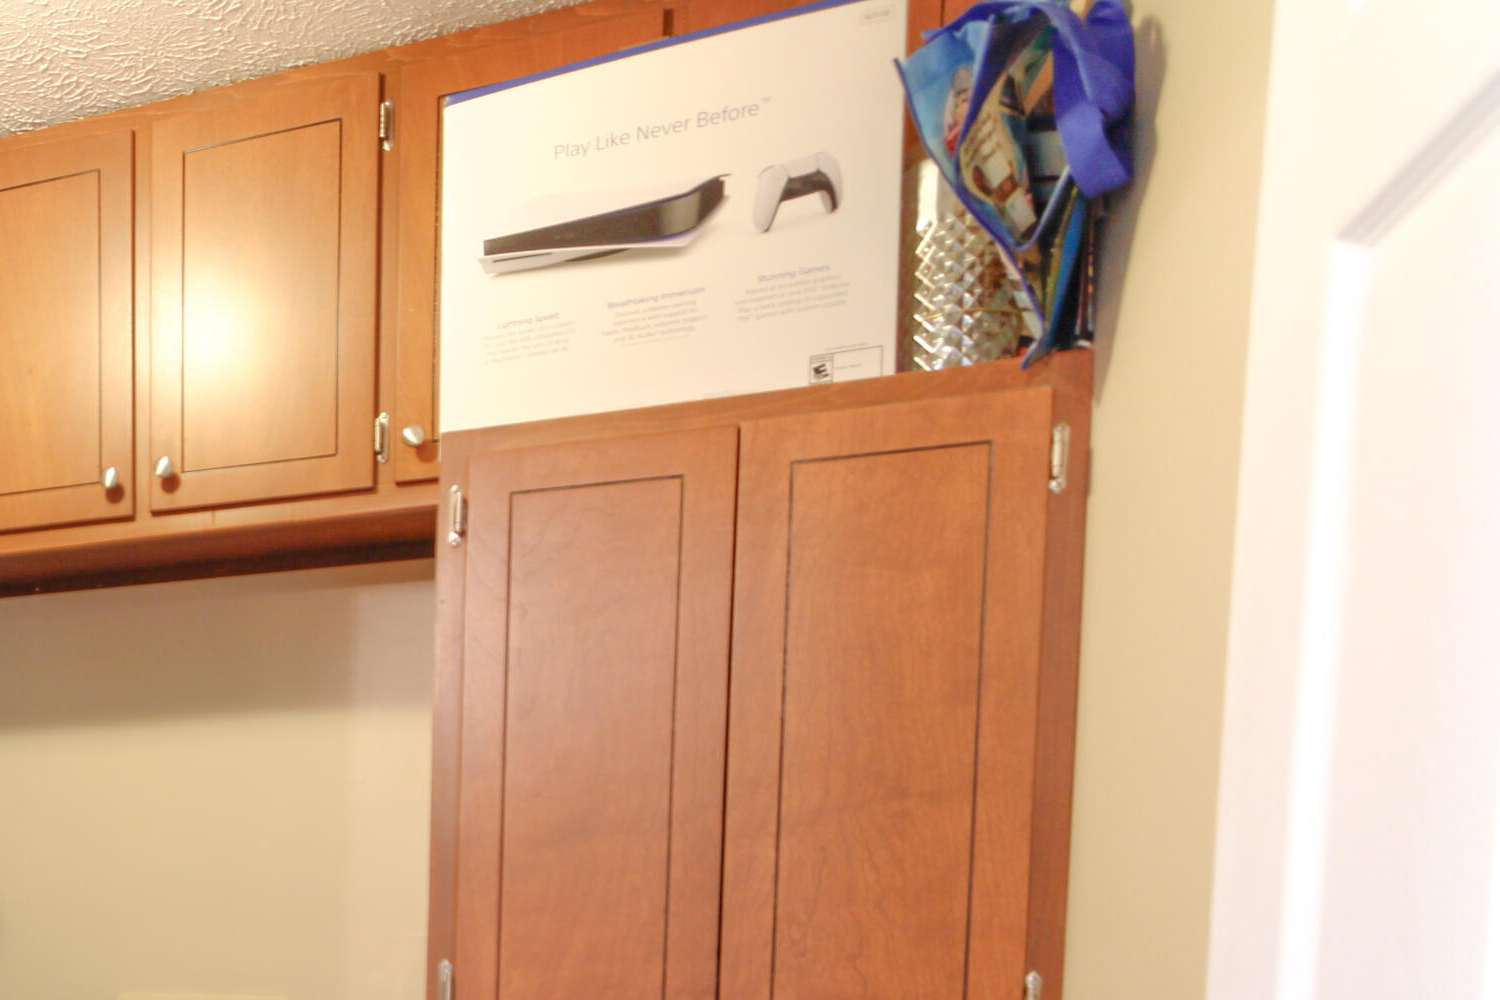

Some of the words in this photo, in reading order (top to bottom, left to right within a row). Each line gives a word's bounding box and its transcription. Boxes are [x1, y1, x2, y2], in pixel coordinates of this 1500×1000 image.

[553, 141, 590, 160] Play
[596, 132, 630, 151] Like
[636, 117, 691, 140] Never
